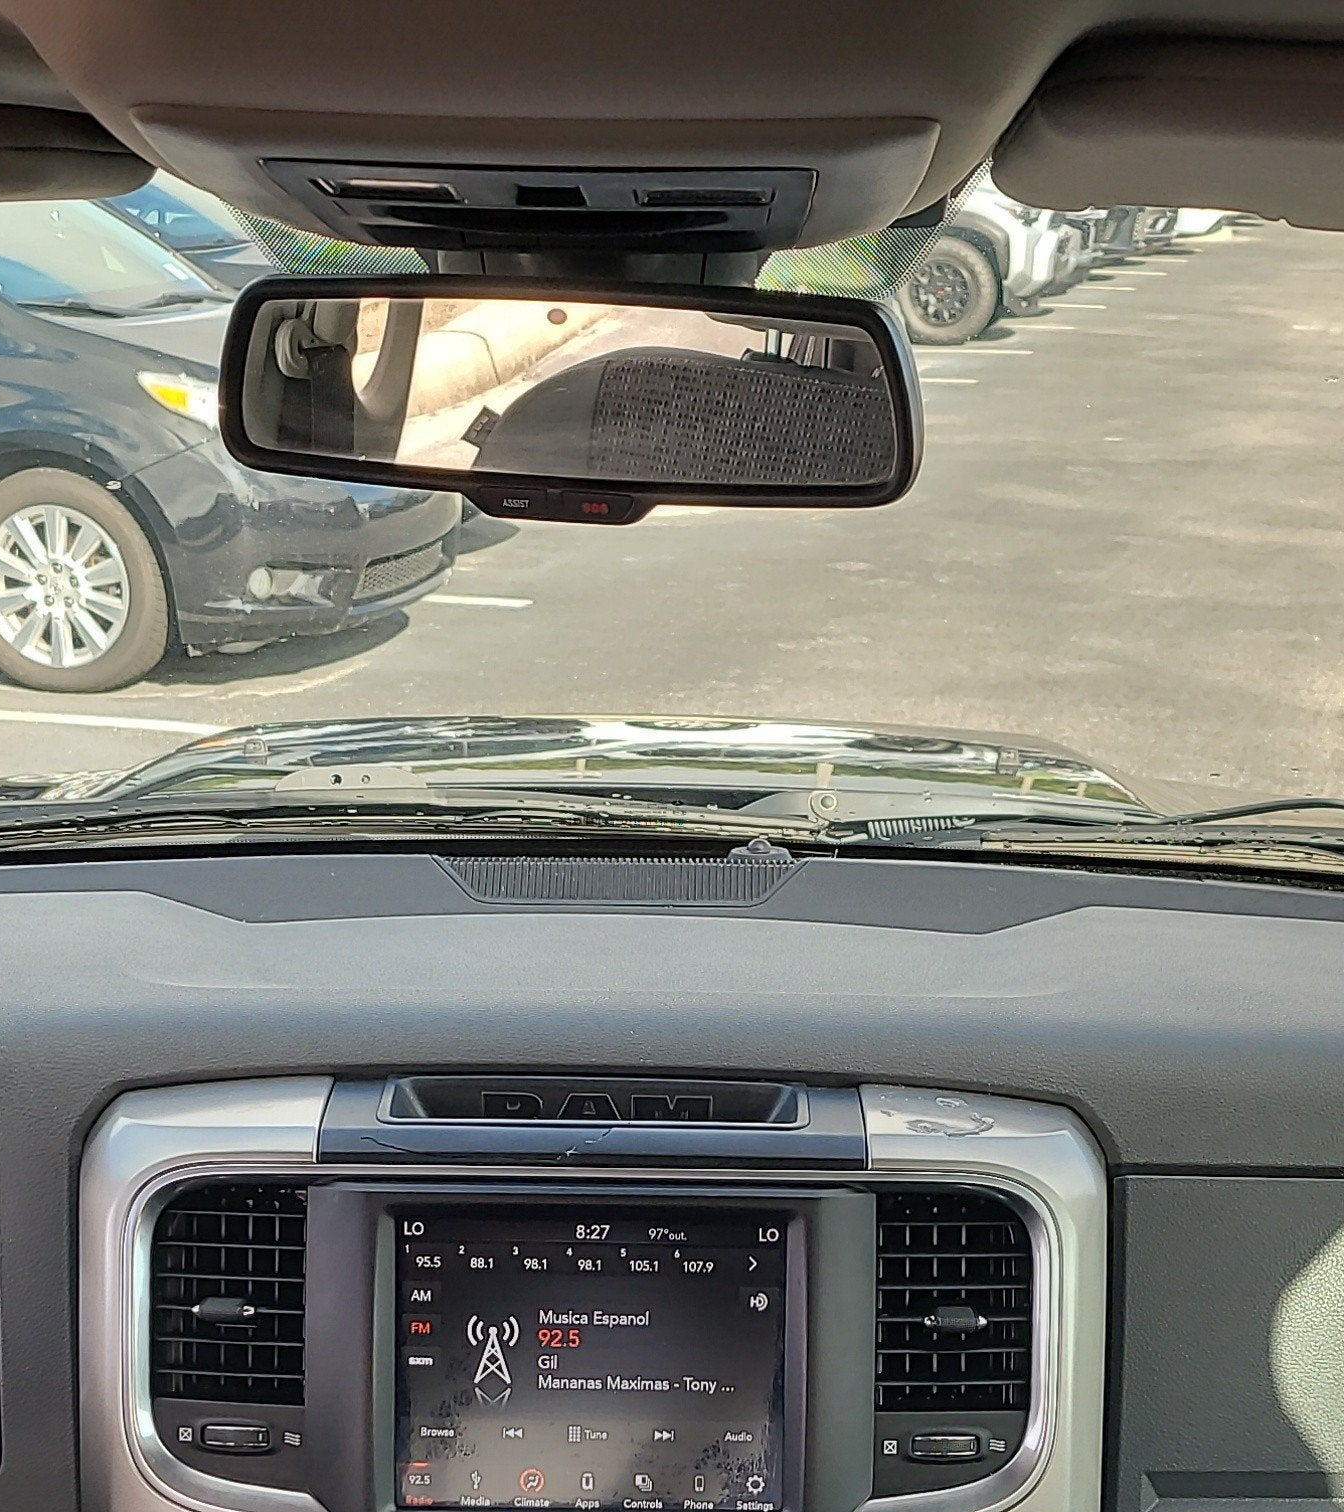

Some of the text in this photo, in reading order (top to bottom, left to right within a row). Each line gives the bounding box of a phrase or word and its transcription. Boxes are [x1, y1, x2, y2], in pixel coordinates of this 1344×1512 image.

[502, 499, 530, 508] ASSIST
[482, 1091, 714, 1120] RAM
[404, 1221, 425, 1235] LO
[575, 1224, 610, 1240] 8:27
[758, 1227, 779, 1242] LO
[405, 1244, 410, 1253] 1
[458, 1245, 465, 1254] 2
[512, 1246, 519, 1255] 3
[565, 1247, 573, 1256] 4
[620, 1248, 627, 1257] 5
[674, 1248, 680, 1258] 6
[415, 1256, 441, 1268] 95.5
[470, 1257, 494, 1269] 88.1
[523, 1258, 547, 1270] 98.1
[577, 1259, 602, 1271] 98.1
[629, 1260, 659, 1272] 105.1
[682, 1261, 714, 1273] 107.9
[410, 1289, 432, 1302] AM
[539, 1310, 649, 1328] Musica Espanol
[411, 1322, 430, 1334] FM
[538, 1330, 580, 1347] 92.5
[538, 1354, 558, 1370] Gil
[538, 1374, 602, 1390] Mananas
[607, 1376, 670, 1391] Maximas
[683, 1377, 717, 1394] Tony
[420, 1426, 455, 1437] Browse
[584, 1429, 608, 1440] Tune
[724, 1431, 753, 1442] Audio
[409, 1474, 431, 1485] 92.5
[406, 1495, 433, 1505] Radio
[461, 1496, 491, 1507] Media
[514, 1497, 550, 1508] Climate
[575, 1499, 600, 1510] Apps
[623, 1499, 662, 1510] Controls
[683, 1500, 714, 1510] Phone
[736, 1501, 774, 1512] Settings
